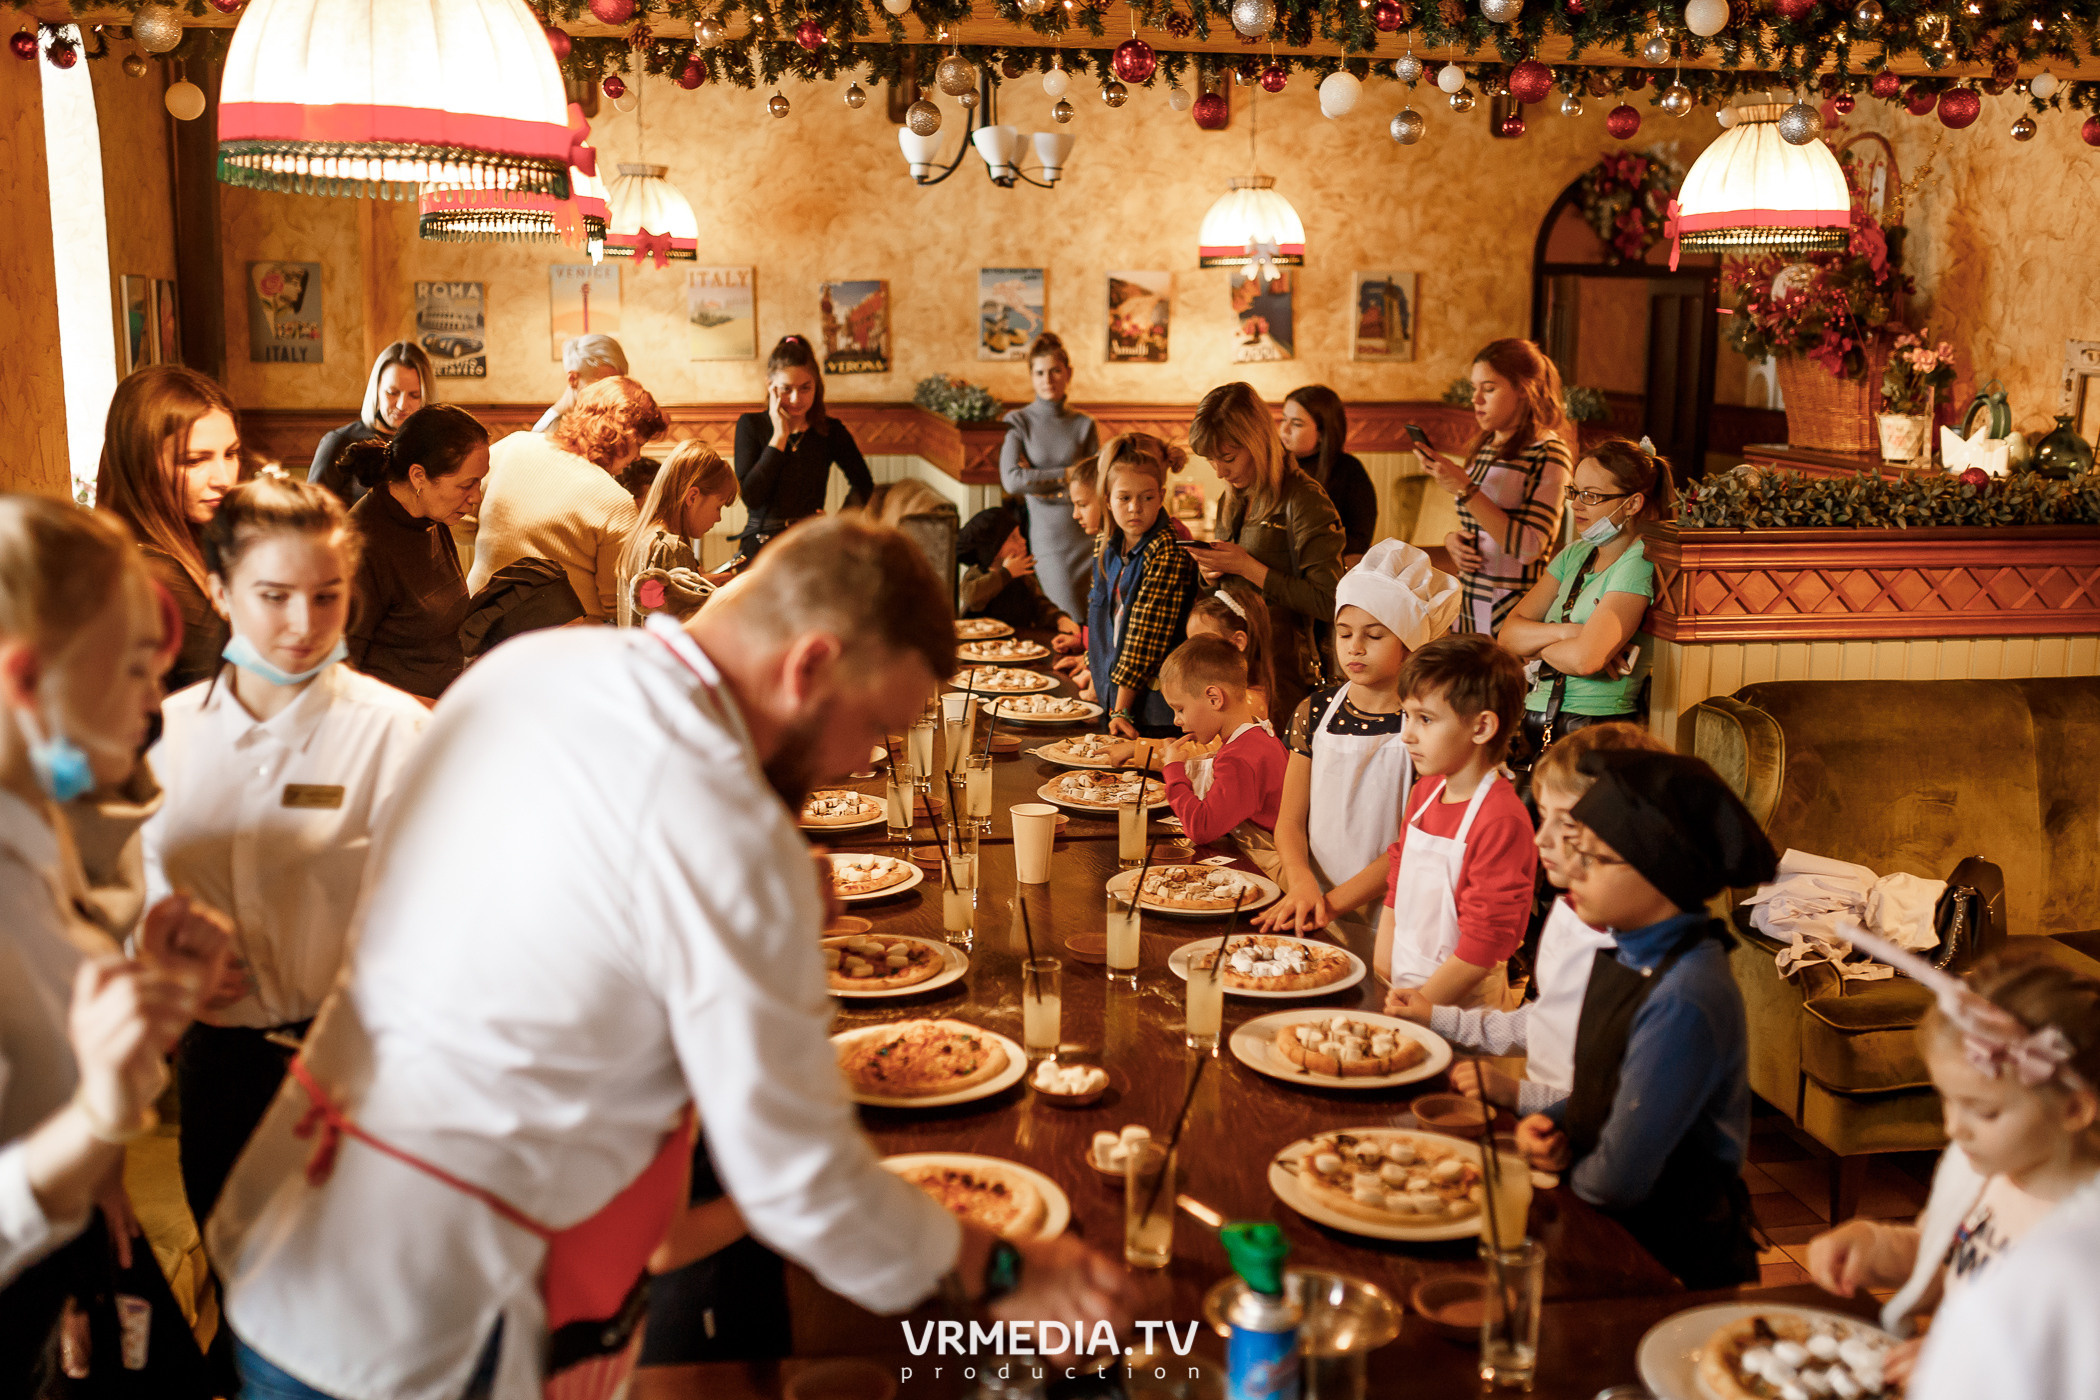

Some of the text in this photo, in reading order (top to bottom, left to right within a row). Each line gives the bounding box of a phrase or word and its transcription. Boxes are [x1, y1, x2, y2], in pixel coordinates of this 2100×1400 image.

[556, 264, 613, 280] VENICE
[689, 269, 750, 288] ITALY
[417, 281, 481, 299] ROMA
[264, 345, 308, 362] ITALY
[827, 360, 884, 373] VERONA
